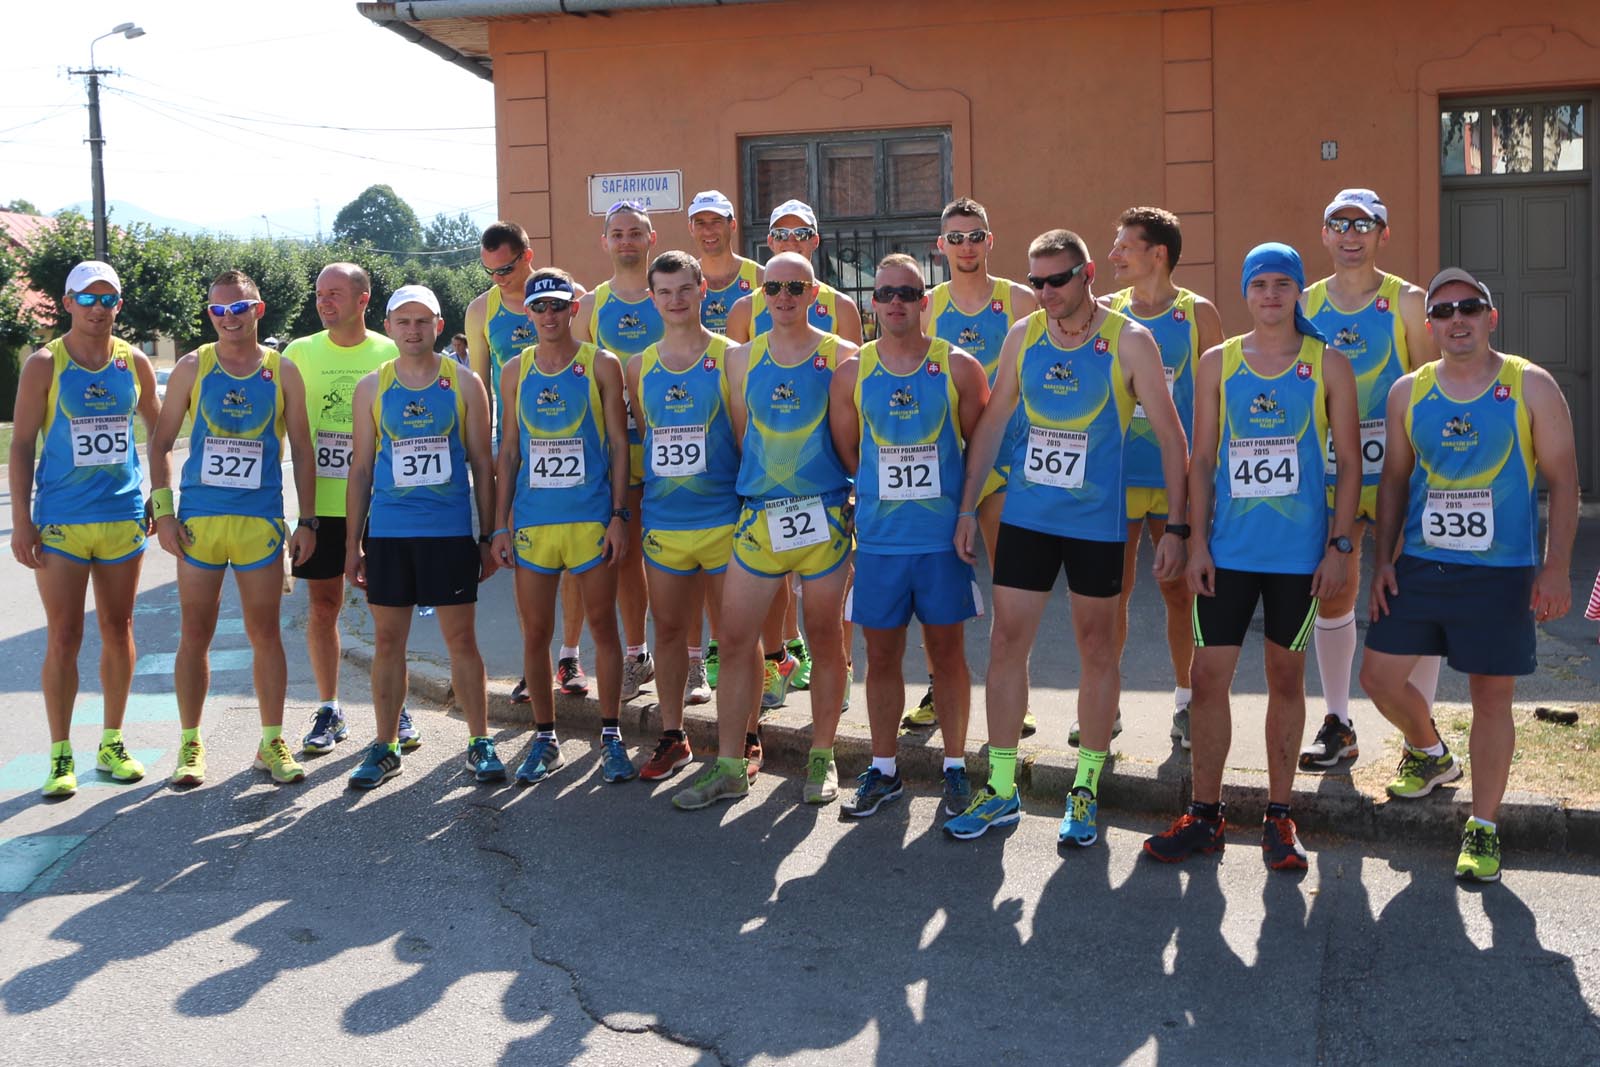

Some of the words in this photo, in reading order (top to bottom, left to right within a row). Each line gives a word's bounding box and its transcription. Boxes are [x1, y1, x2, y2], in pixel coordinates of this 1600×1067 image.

[602, 176, 668, 194] ŠAFÁRIKOVA
[534, 278, 556, 292] KVL
[77, 432, 128, 456] 305
[656, 443, 700, 466] 339
[1328, 440, 1384, 463] 50
[208, 455, 257, 478] 327
[403, 454, 441, 476] 371
[533, 456, 581, 478] 422
[1029, 447, 1080, 476] 567
[1234, 458, 1294, 485] 464
[888, 464, 932, 489] 312
[779, 512, 815, 538] 32
[1430, 512, 1487, 537] 338
